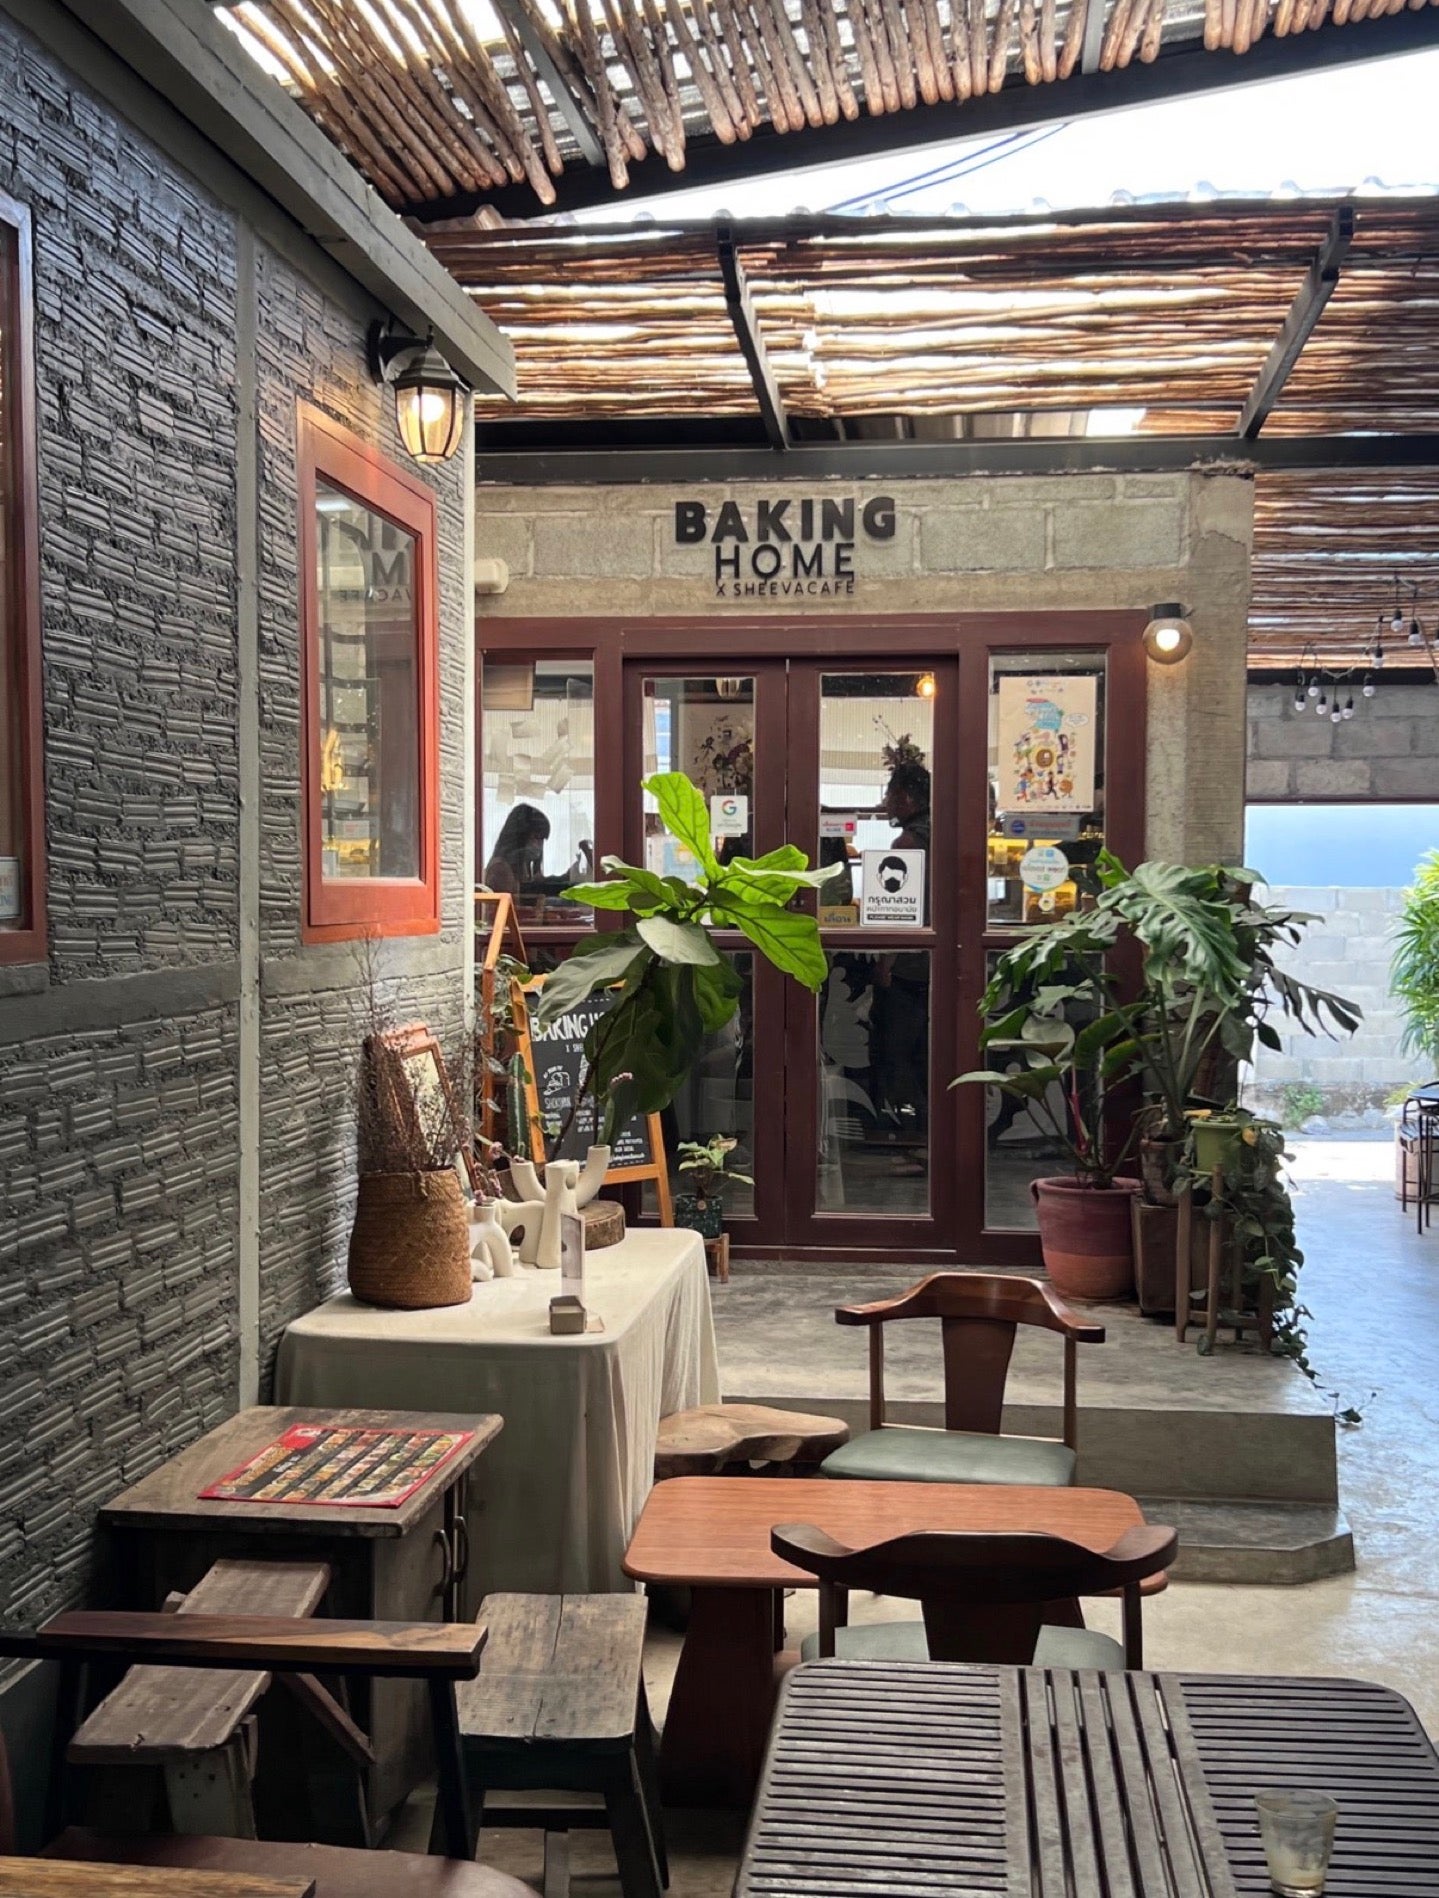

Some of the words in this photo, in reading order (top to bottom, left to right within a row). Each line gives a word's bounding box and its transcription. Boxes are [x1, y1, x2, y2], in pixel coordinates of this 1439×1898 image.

[675, 496, 895, 542] BAKING
[715, 543, 855, 580] HOME
[716, 583, 726, 597] X
